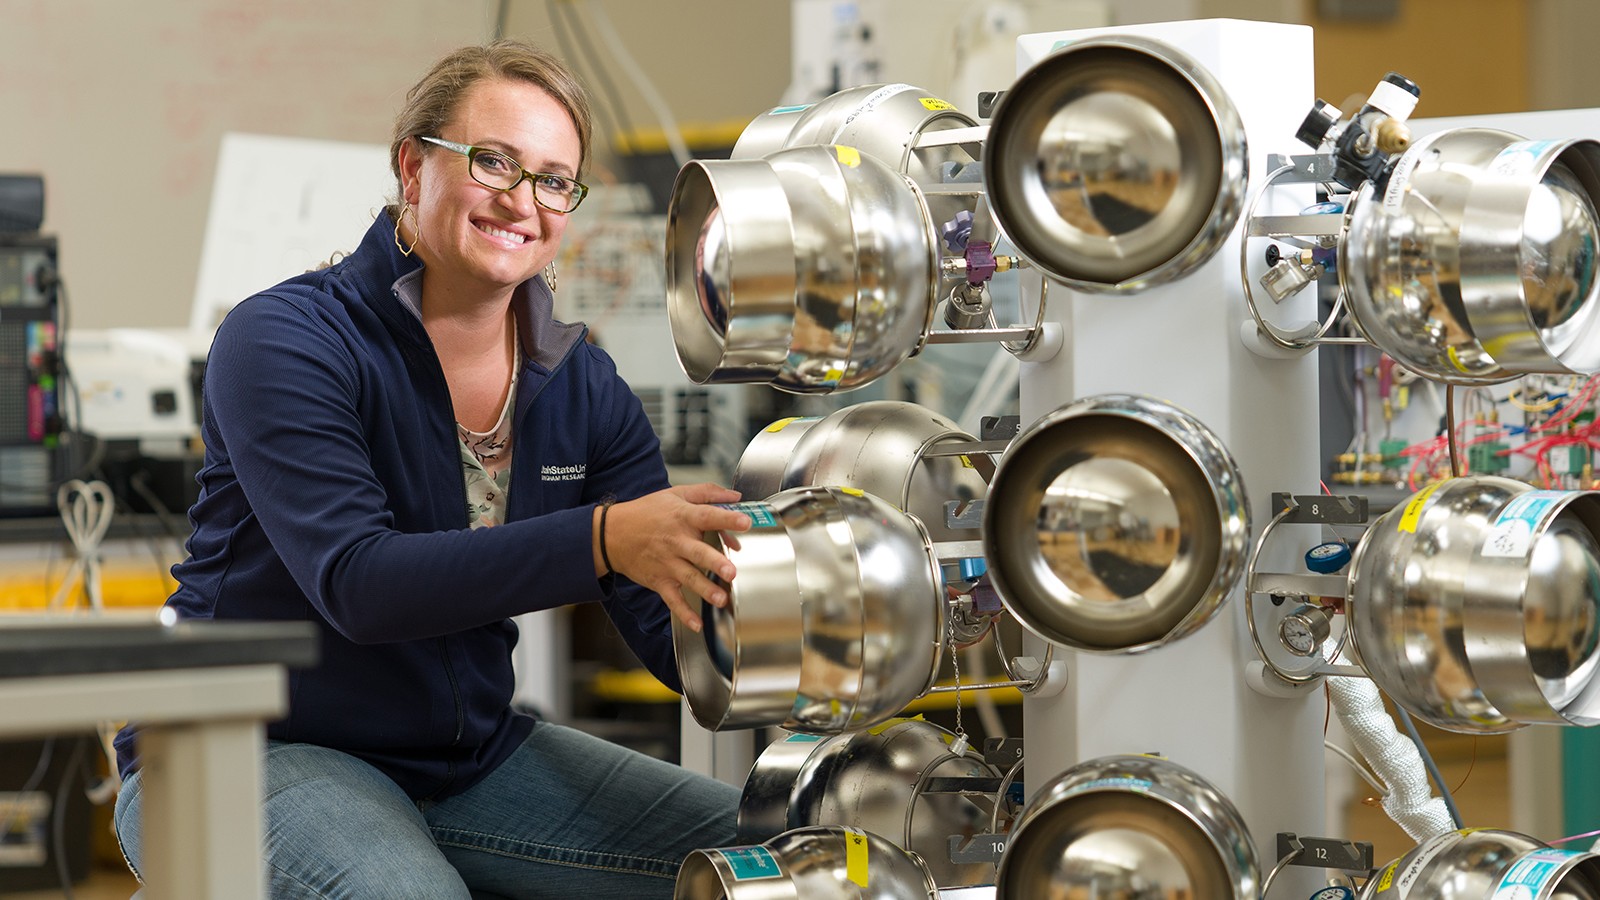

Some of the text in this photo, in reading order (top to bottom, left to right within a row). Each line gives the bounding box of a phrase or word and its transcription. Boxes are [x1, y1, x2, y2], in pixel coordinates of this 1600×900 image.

[1307, 162, 1315, 174] 4
[1312, 504, 1319, 515] 8
[1016, 747, 1023, 758] 9
[991, 841, 1005, 853] 10
[1315, 847, 1327, 859] 12
